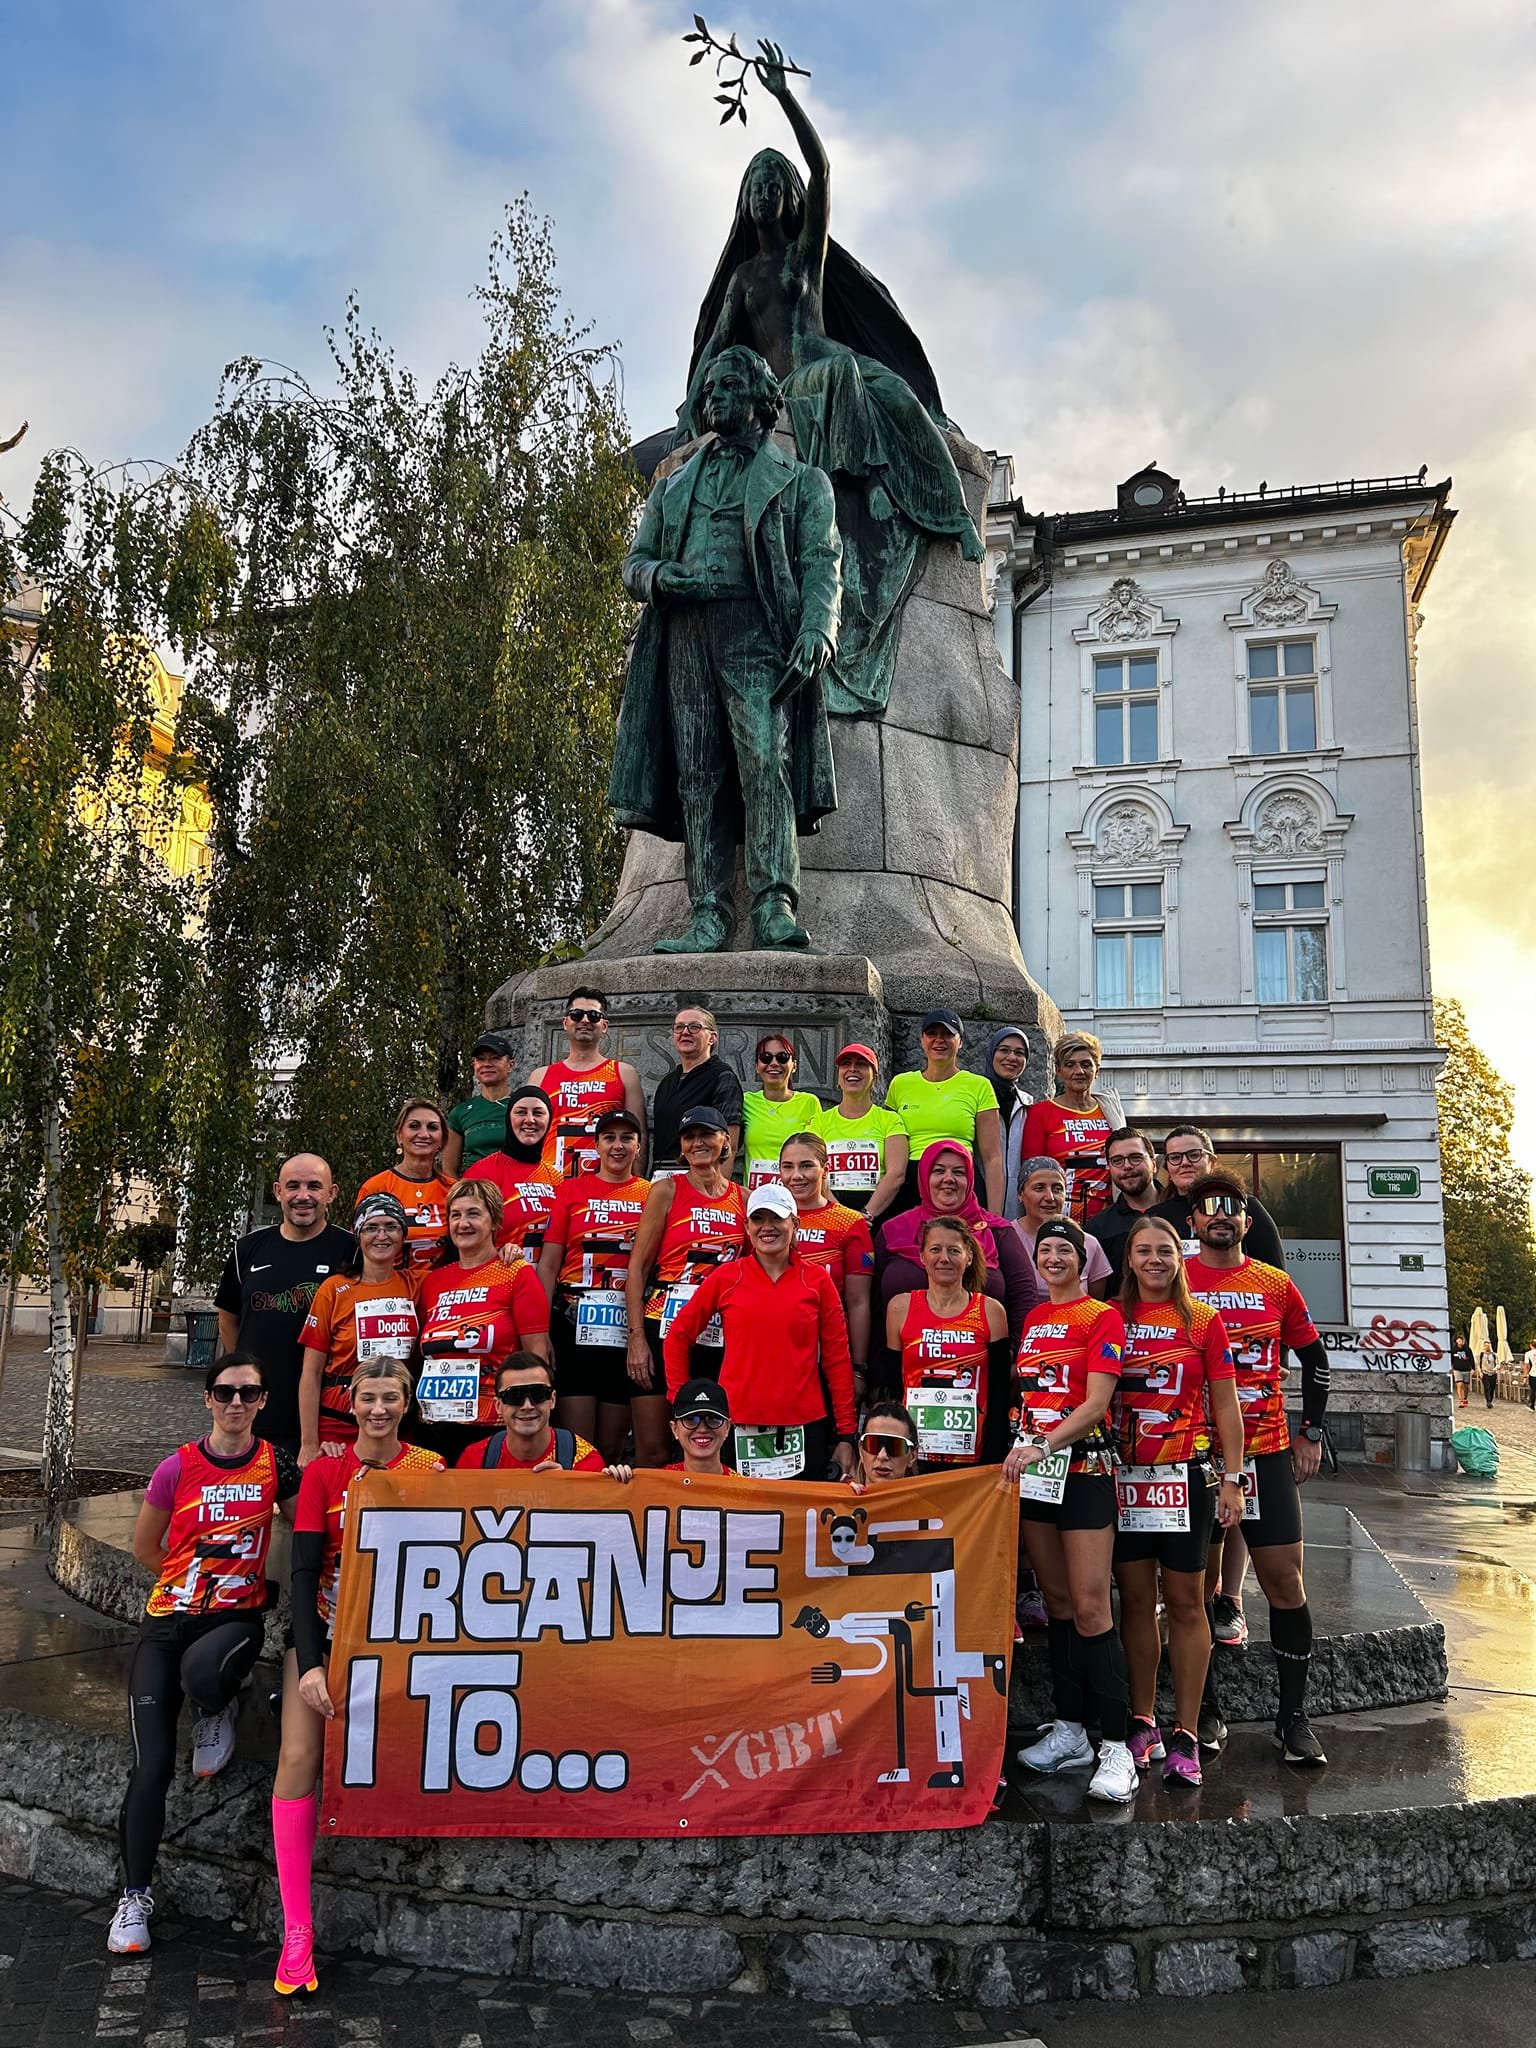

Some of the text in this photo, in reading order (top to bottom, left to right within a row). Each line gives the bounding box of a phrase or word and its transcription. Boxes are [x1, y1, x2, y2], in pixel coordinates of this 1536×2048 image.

[834, 1154, 877, 1170] E 6112
[1388, 1183, 1400, 1192] TRG
[587, 1199, 643, 1213] TRČANJE
[690, 1207, 737, 1226] TRČANJE
[1409, 1256, 1414, 1265] 5
[587, 1307, 597, 1324] D
[601, 1308, 628, 1326] 1108
[921, 1328, 976, 1344] TRČANJE
[917, 1408, 972, 1429] E 852
[747, 1438, 756, 1457] E
[201, 1484, 262, 1503] TRČANJE
[1126, 1485, 1138, 1506] D
[1146, 1485, 1184, 1506] 4613
[357, 1507, 783, 1642] TRČANJE
[341, 1650, 629, 1793] I TO...
